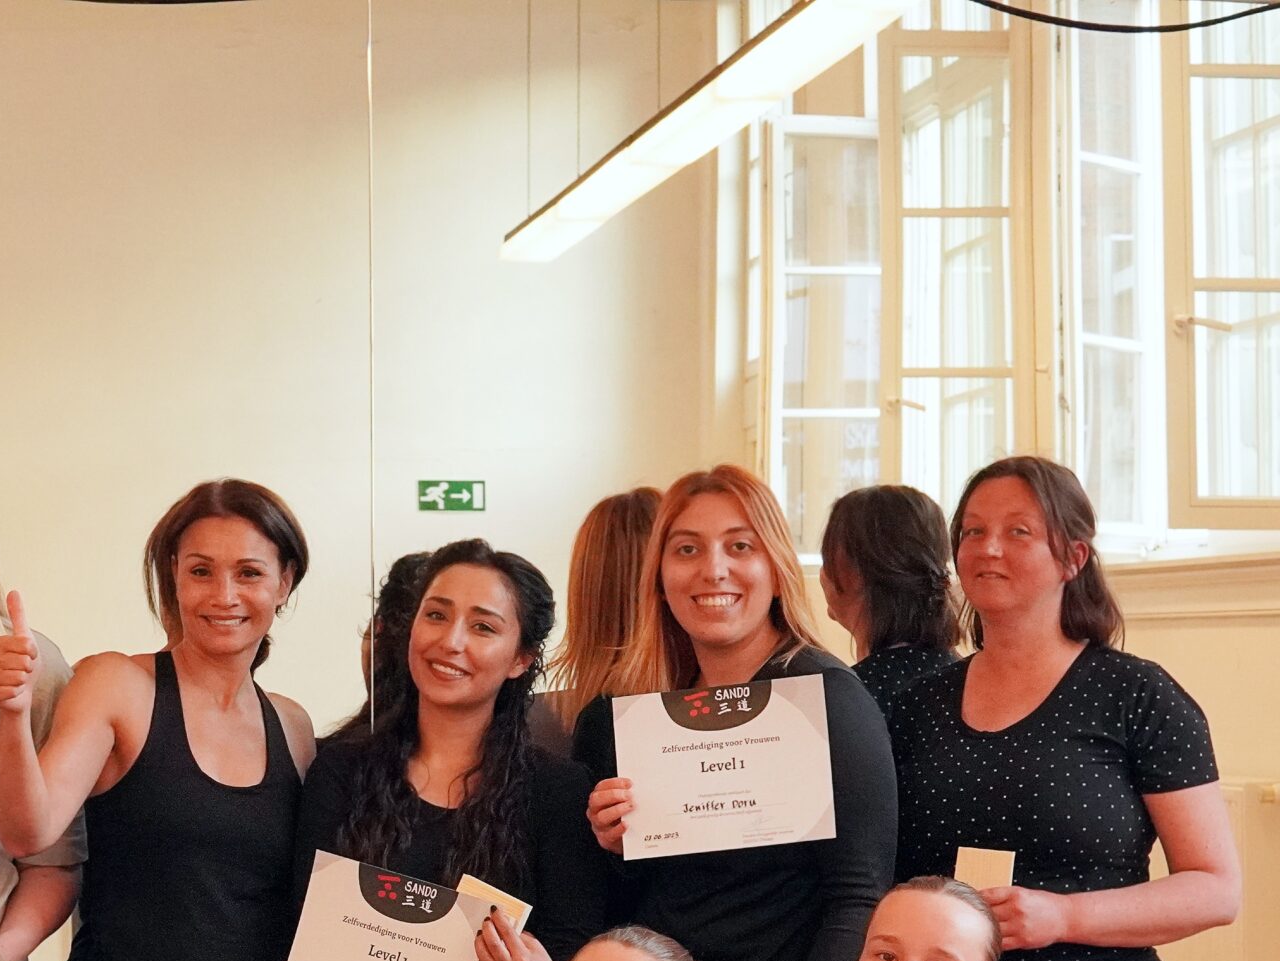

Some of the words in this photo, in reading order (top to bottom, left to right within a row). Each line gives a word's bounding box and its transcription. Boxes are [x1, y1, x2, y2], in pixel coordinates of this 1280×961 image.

[714, 686, 751, 701] SANDO
[661, 741, 724, 754] Zelfverdediging
[725, 739, 743, 747] voor
[744, 735, 781, 745] Vrouwen
[701, 758, 736, 773] Level
[739, 760, 745, 769] 1
[404, 881, 437, 899] SANDO
[342, 915, 397, 940] Zelfverdediging
[397, 932, 414, 943] voor
[415, 937, 446, 954] Vrouwen
